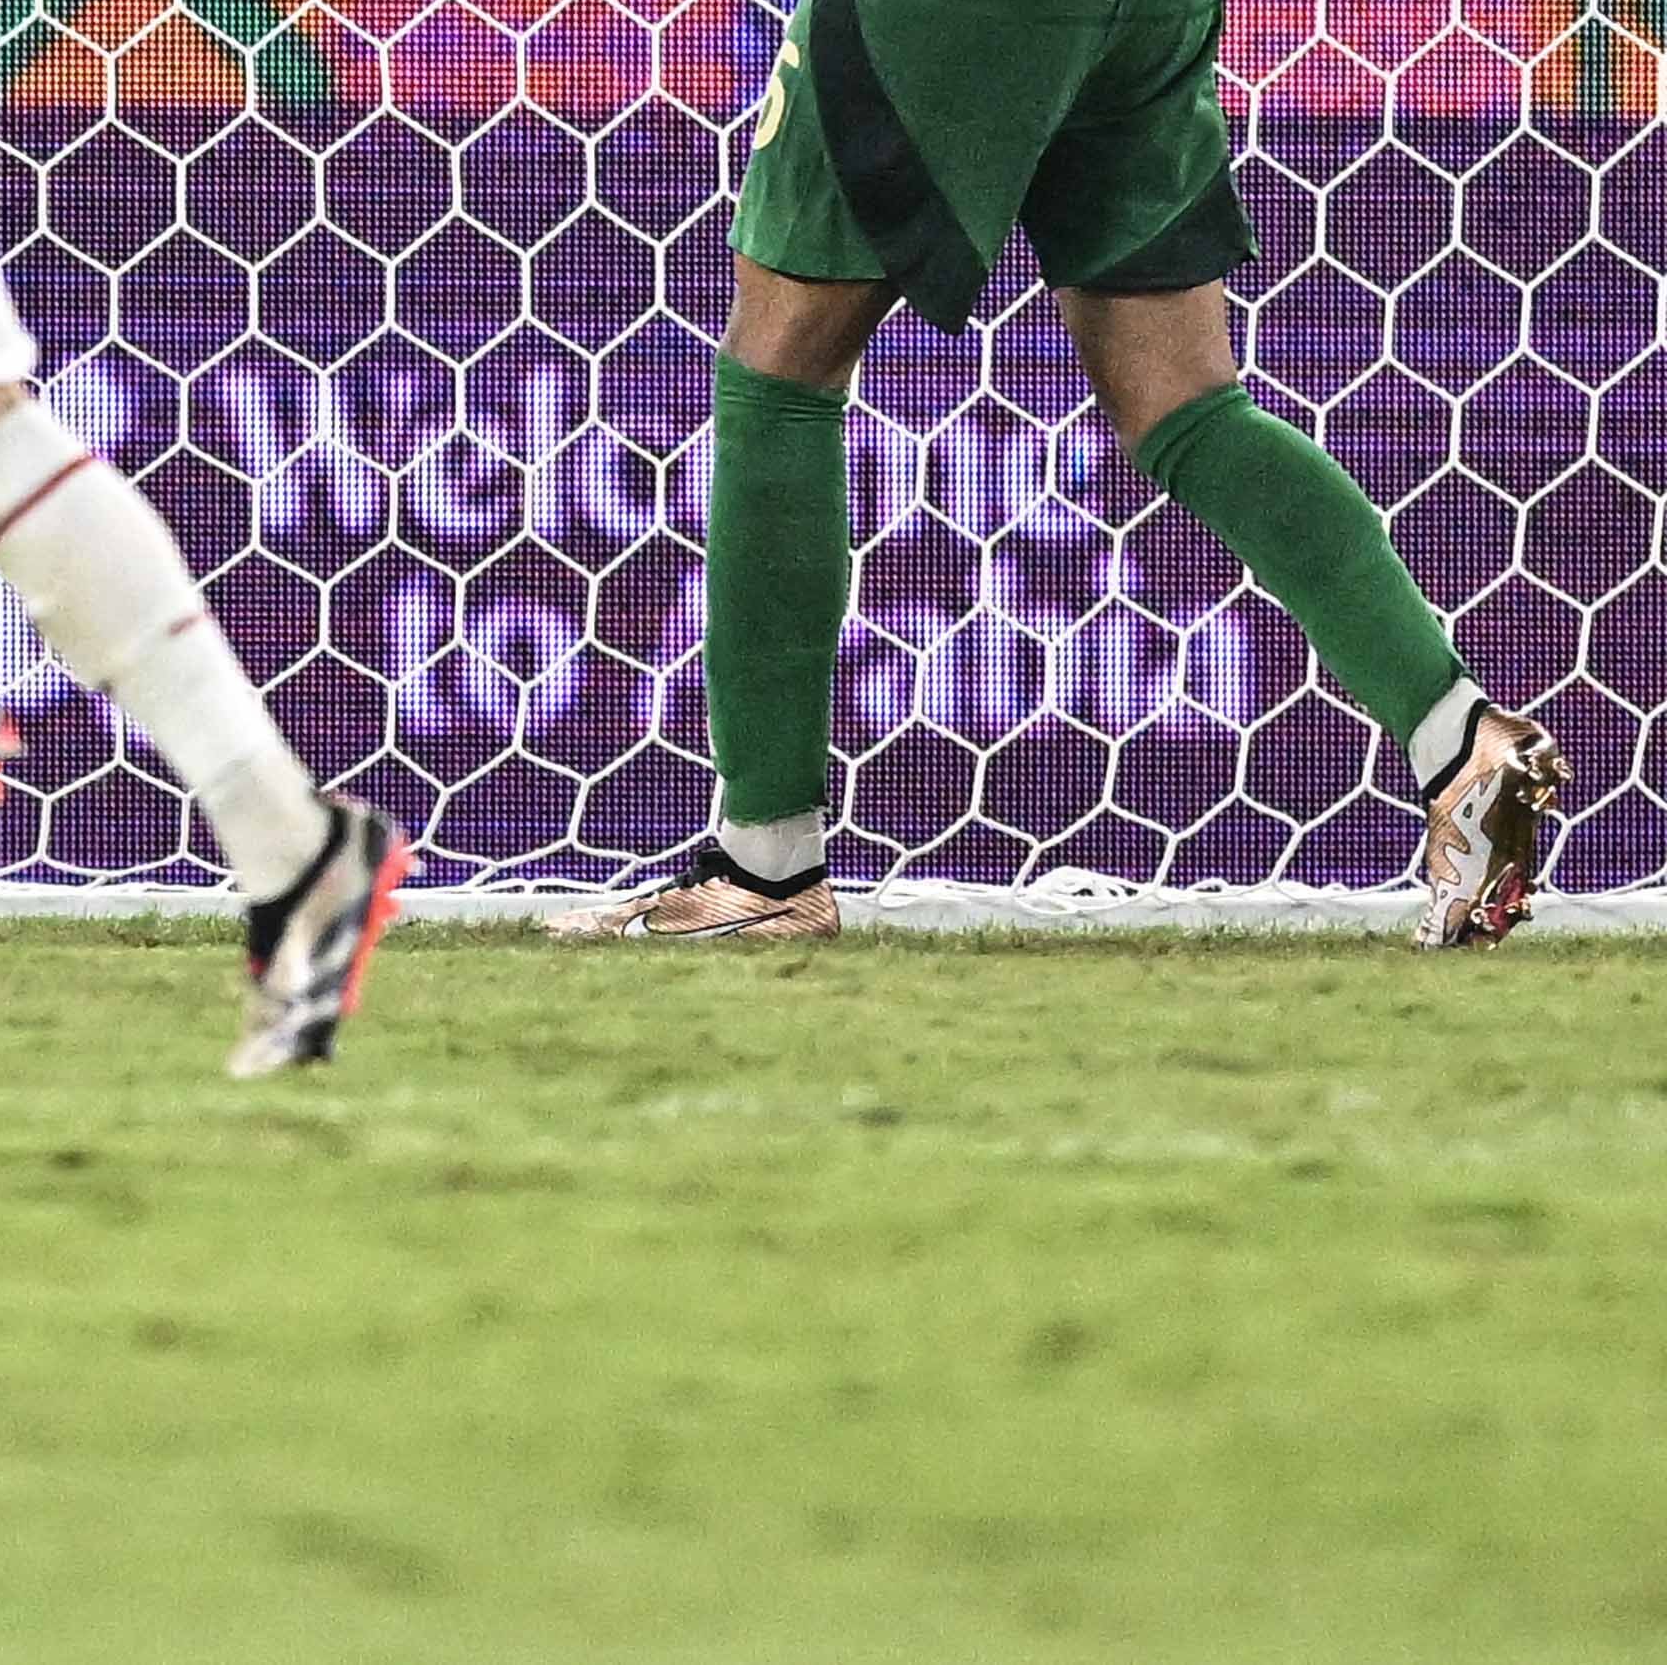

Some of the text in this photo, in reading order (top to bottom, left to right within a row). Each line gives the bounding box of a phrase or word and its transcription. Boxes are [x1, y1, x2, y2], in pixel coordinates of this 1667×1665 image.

[217, 364, 1107, 536] Welcme
[385, 574, 582, 734] to
[639, 546, 1255, 736] abia
